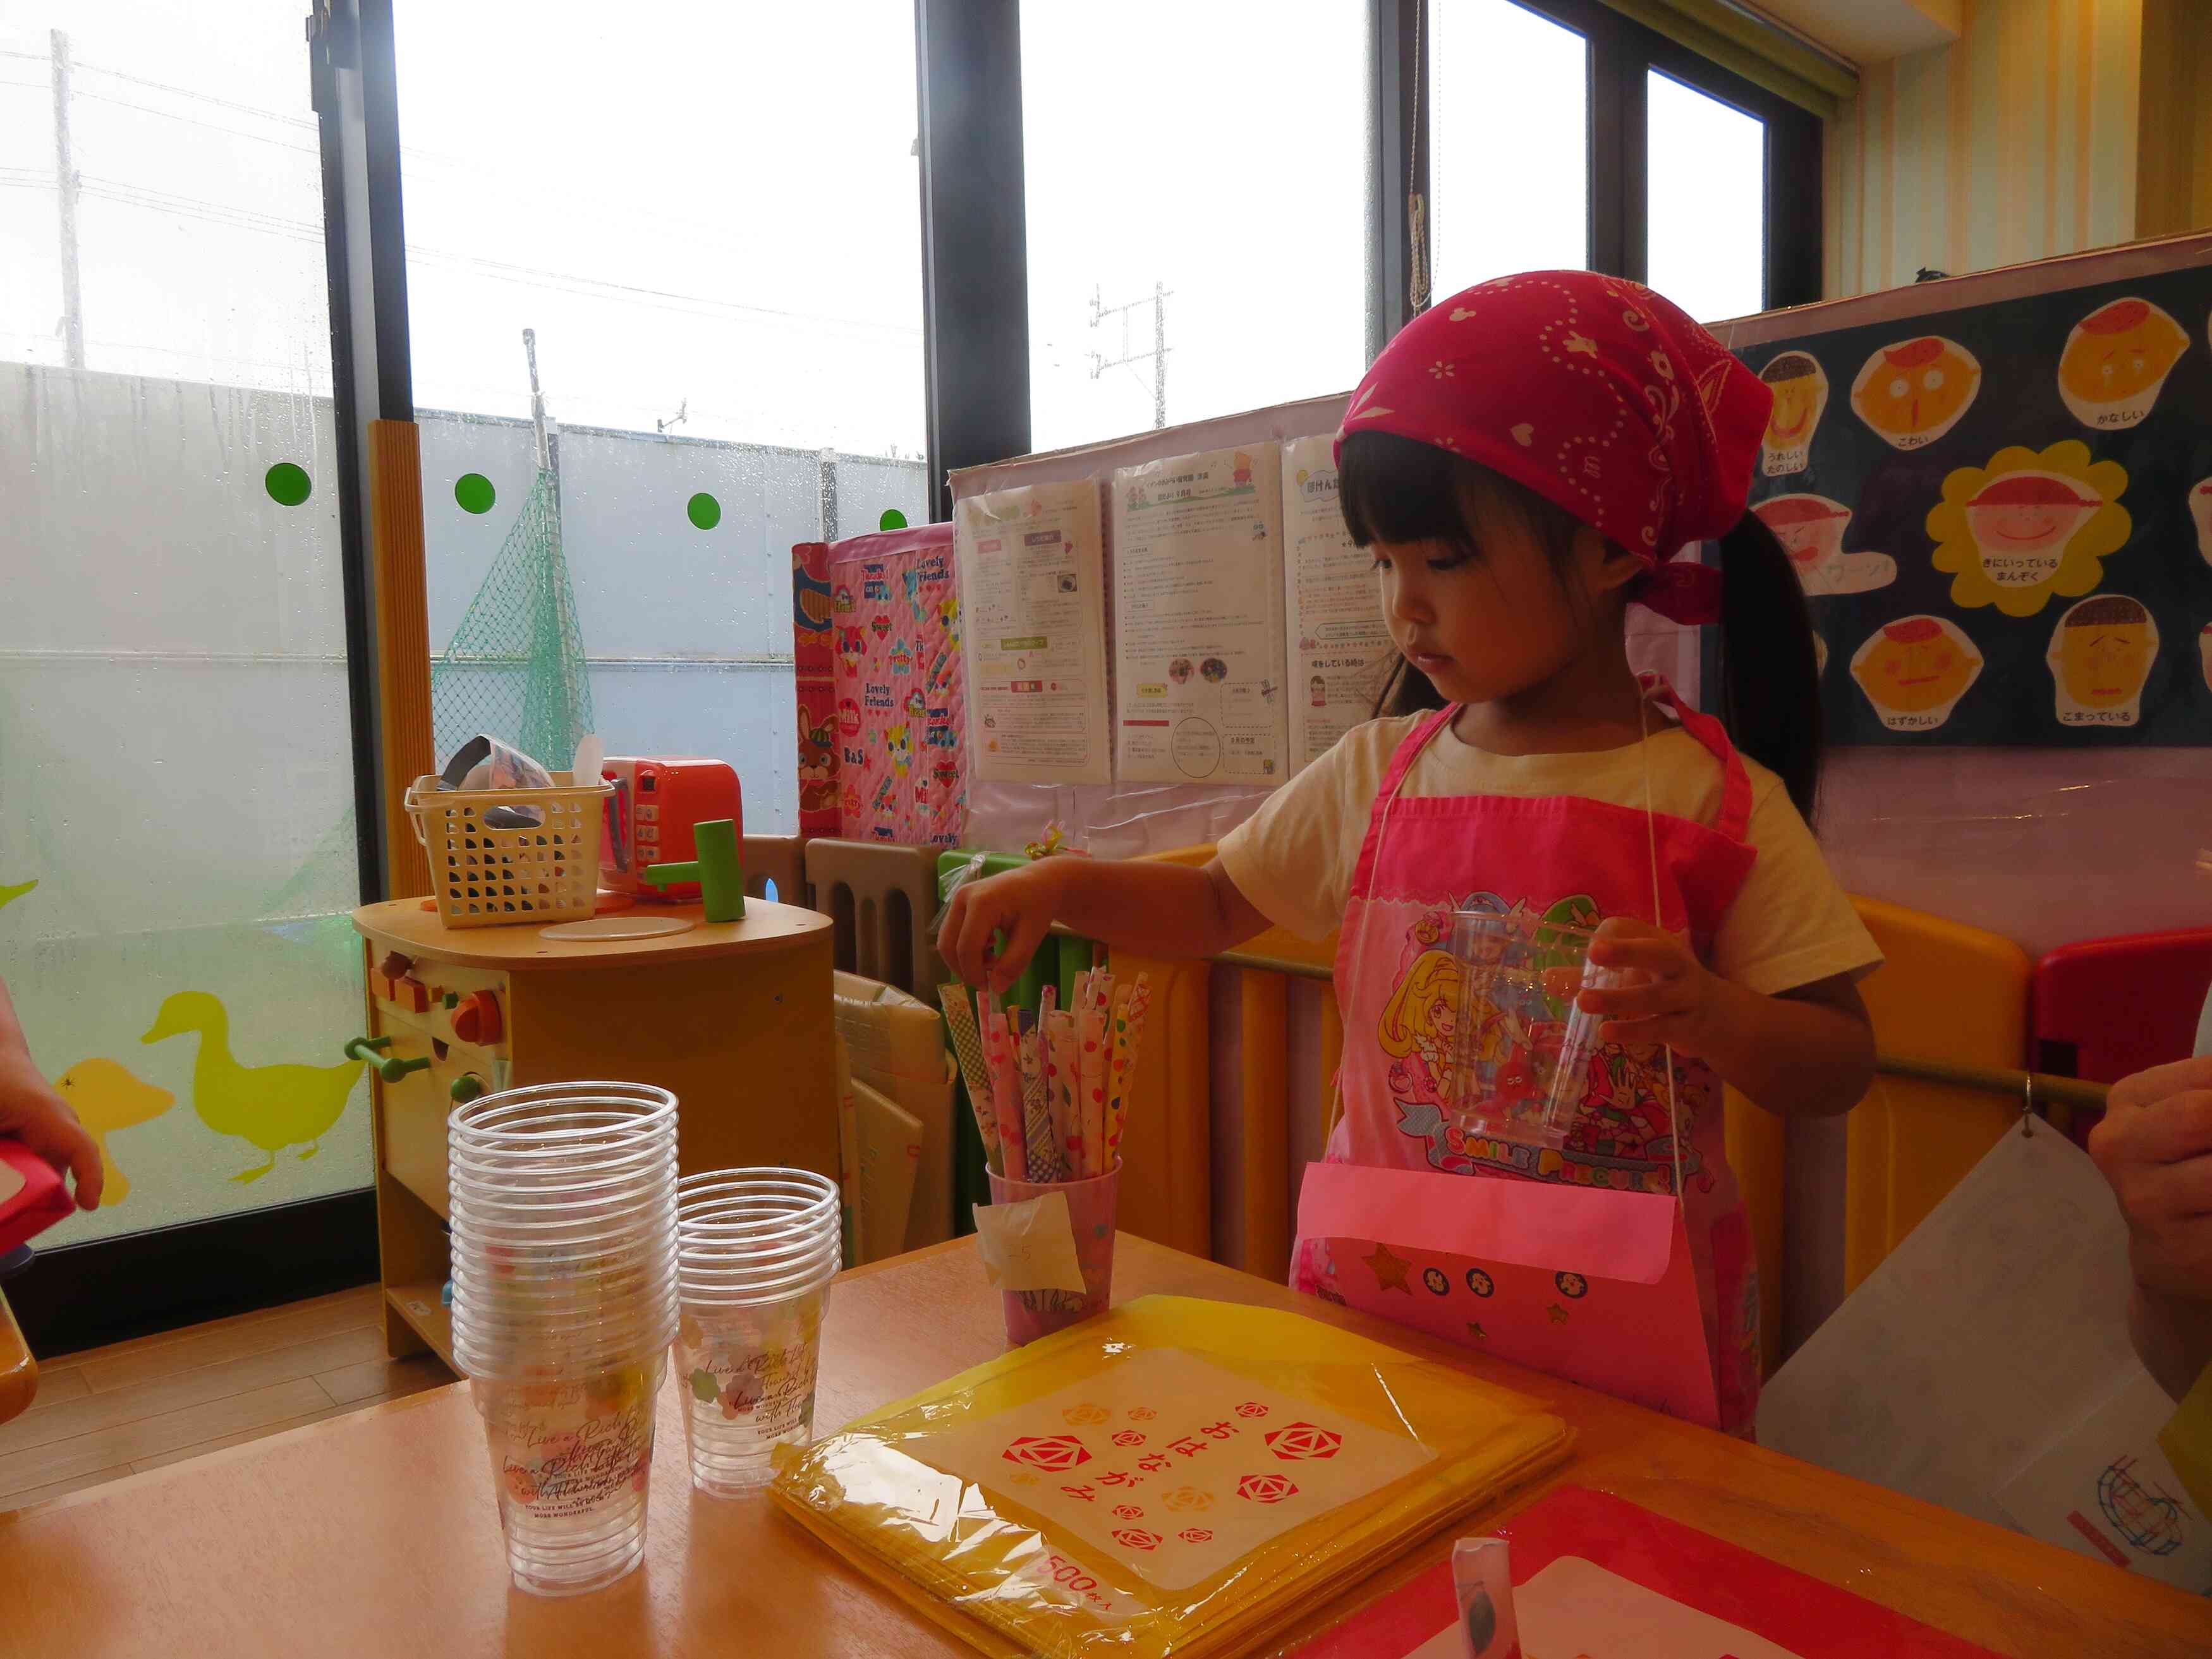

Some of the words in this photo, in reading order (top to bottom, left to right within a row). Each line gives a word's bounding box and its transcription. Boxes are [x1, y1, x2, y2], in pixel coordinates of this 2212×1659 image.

[2096, 410, 2144, 425] かなしい
[1898, 435, 1929, 446] こわい
[1768, 451, 1803, 462] うれしい
[1767, 463, 1804, 474] たのしい
[1982, 557, 2058, 568] きにいっている
[1996, 571, 2039, 581] まんぞく
[866, 683, 890, 695] Lovely
[865, 696, 894, 707] Friends
[1887, 715, 1938, 726] はずかしい
[2063, 712, 2130, 721] こまっている
[1444, 1126, 1531, 1169] SMILE
[1060, 1420, 1240, 1503] おはながみ
